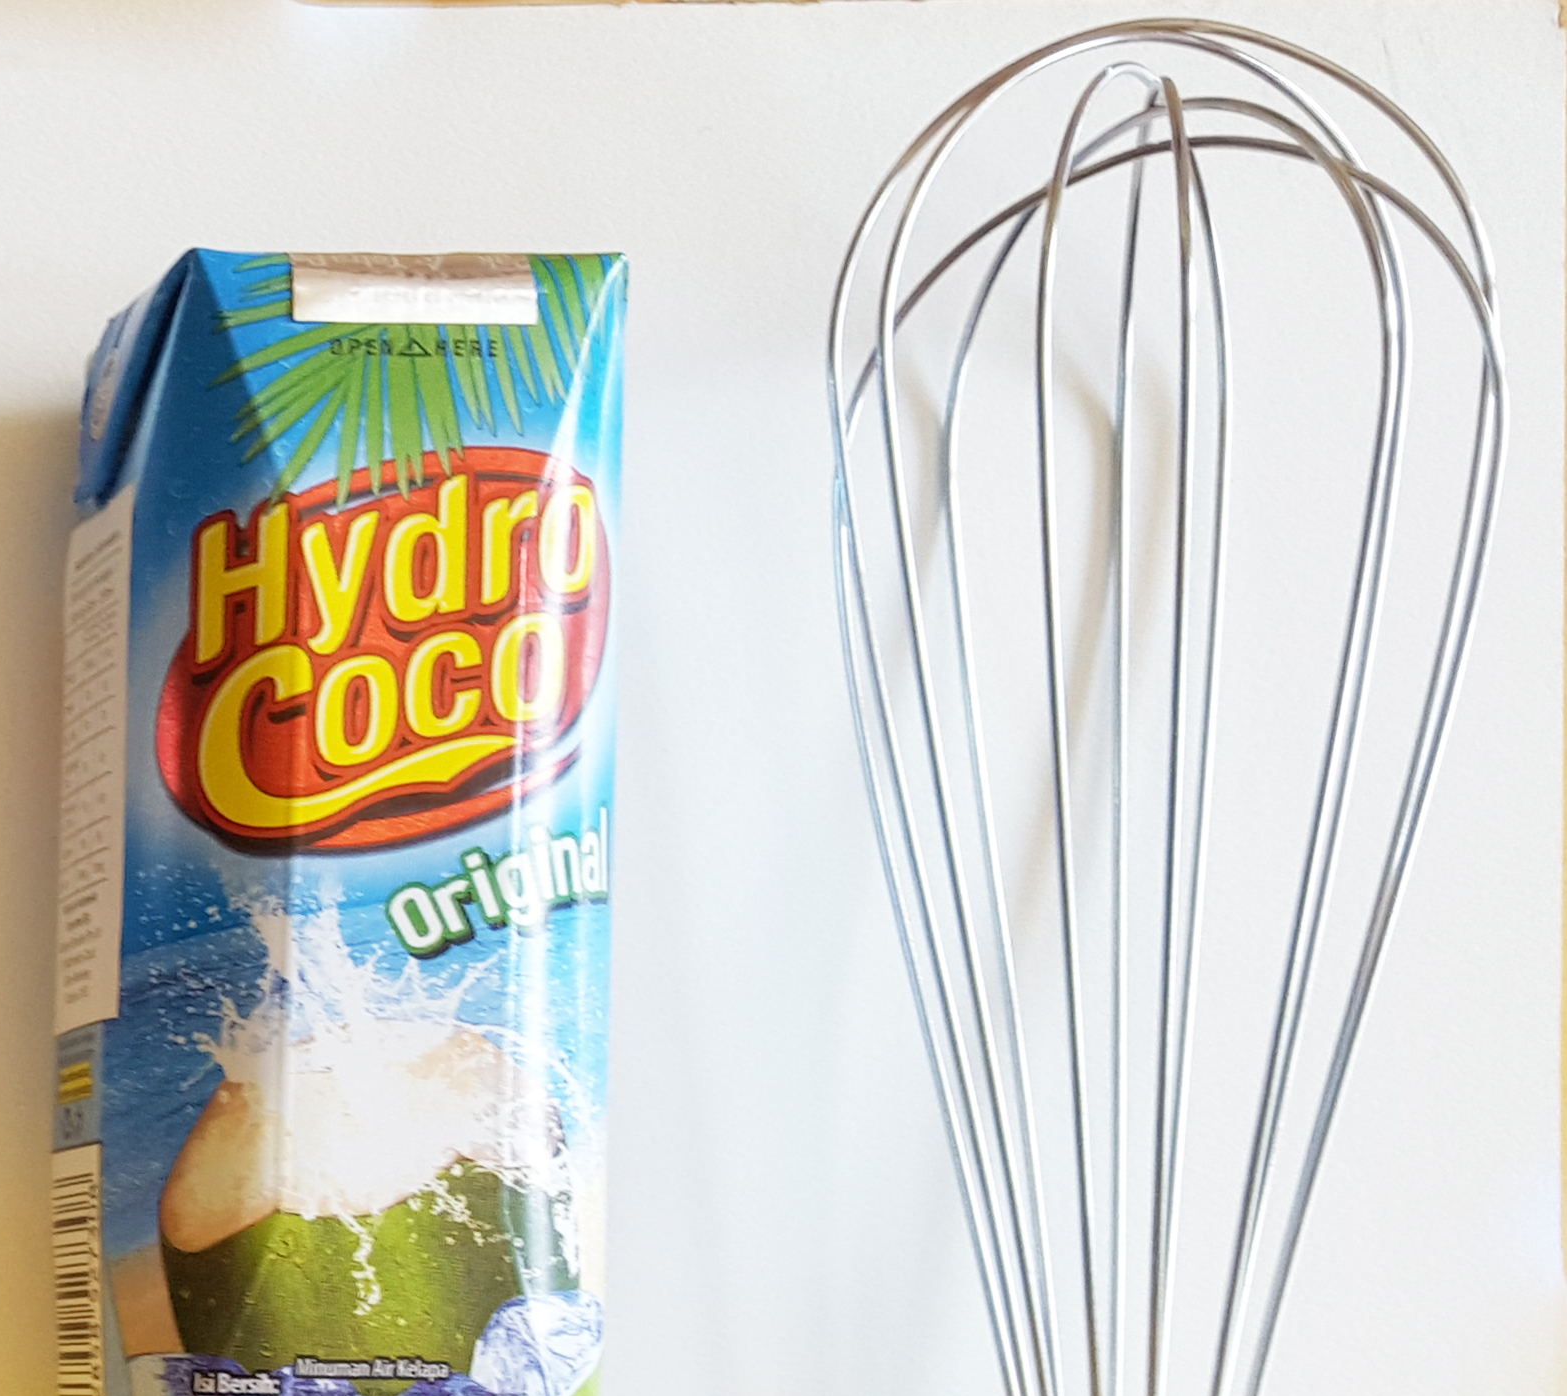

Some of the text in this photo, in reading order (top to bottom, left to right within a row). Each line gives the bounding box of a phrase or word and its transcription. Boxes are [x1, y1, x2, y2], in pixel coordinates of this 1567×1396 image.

[194, 473, 599, 666] Hydro
[197, 613, 564, 828] Coco
[387, 804, 609, 955] Original
